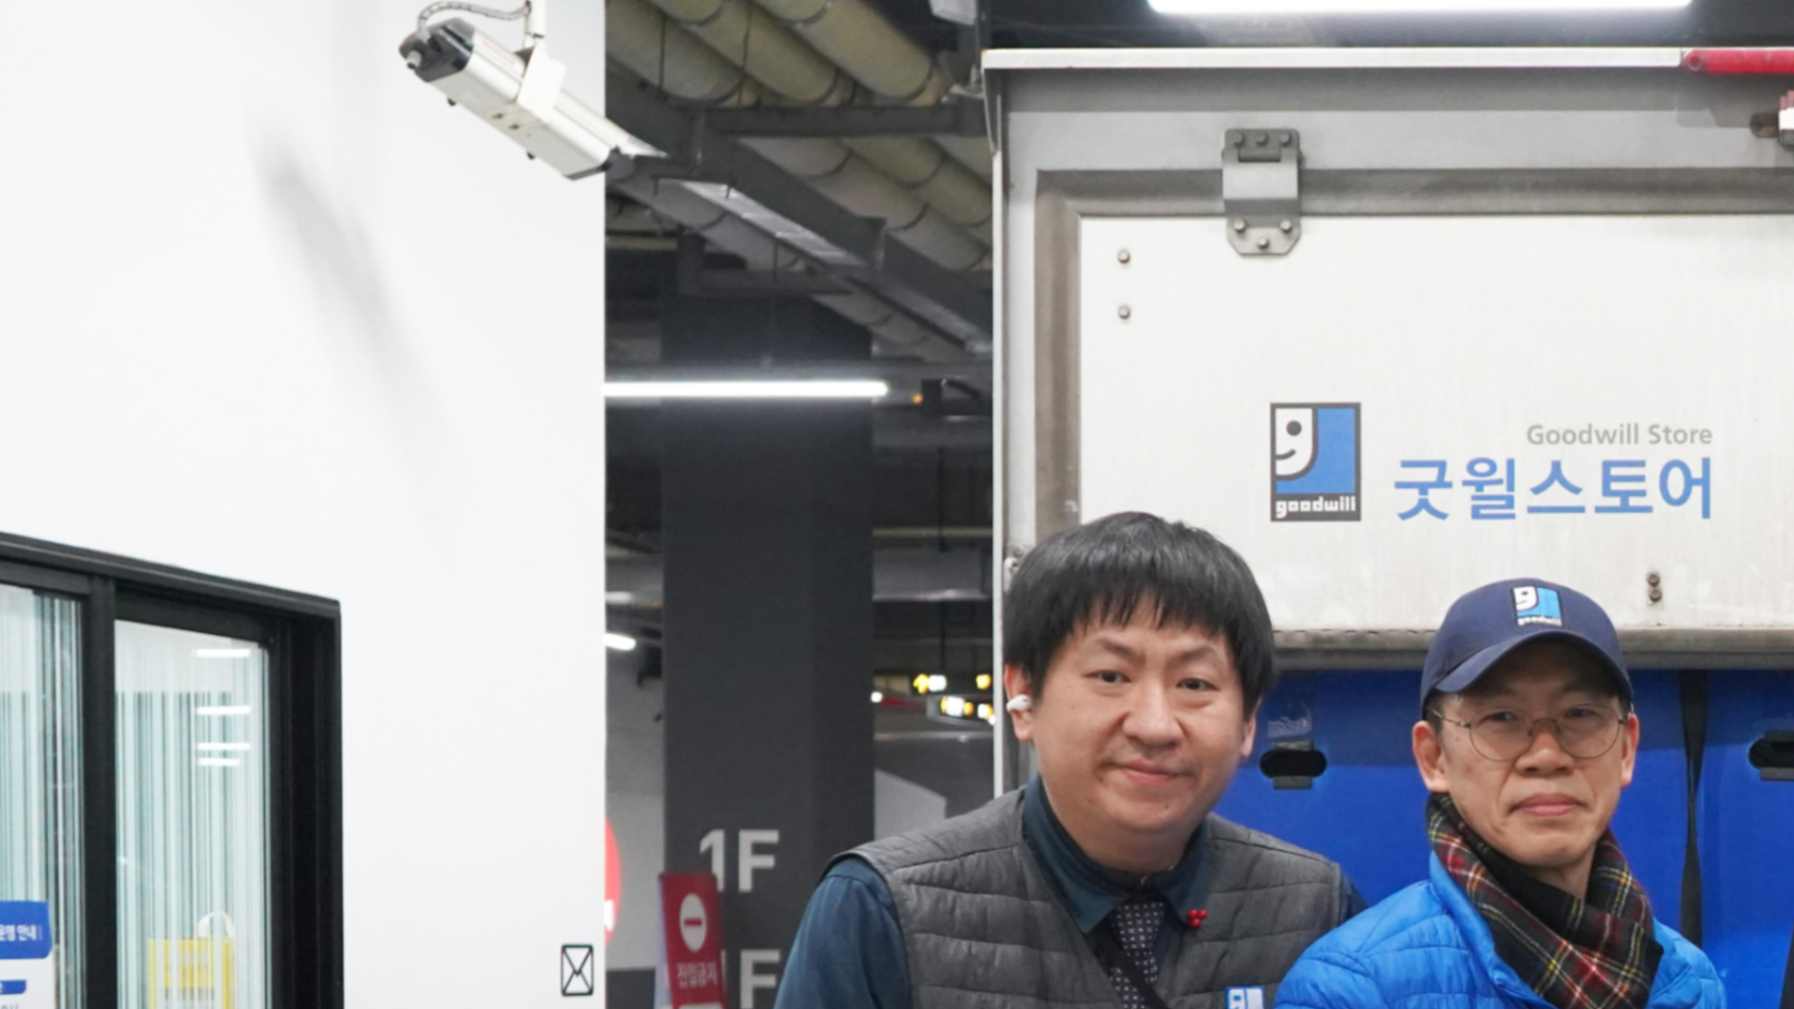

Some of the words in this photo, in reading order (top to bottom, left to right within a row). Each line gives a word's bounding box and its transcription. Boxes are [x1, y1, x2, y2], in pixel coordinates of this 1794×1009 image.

[1526, 423, 1639, 445] Goodwill
[1648, 424, 1713, 445] Store
[1393, 456, 1711, 521] 굿윌스토어
[1275, 496, 1357, 519] goodwill
